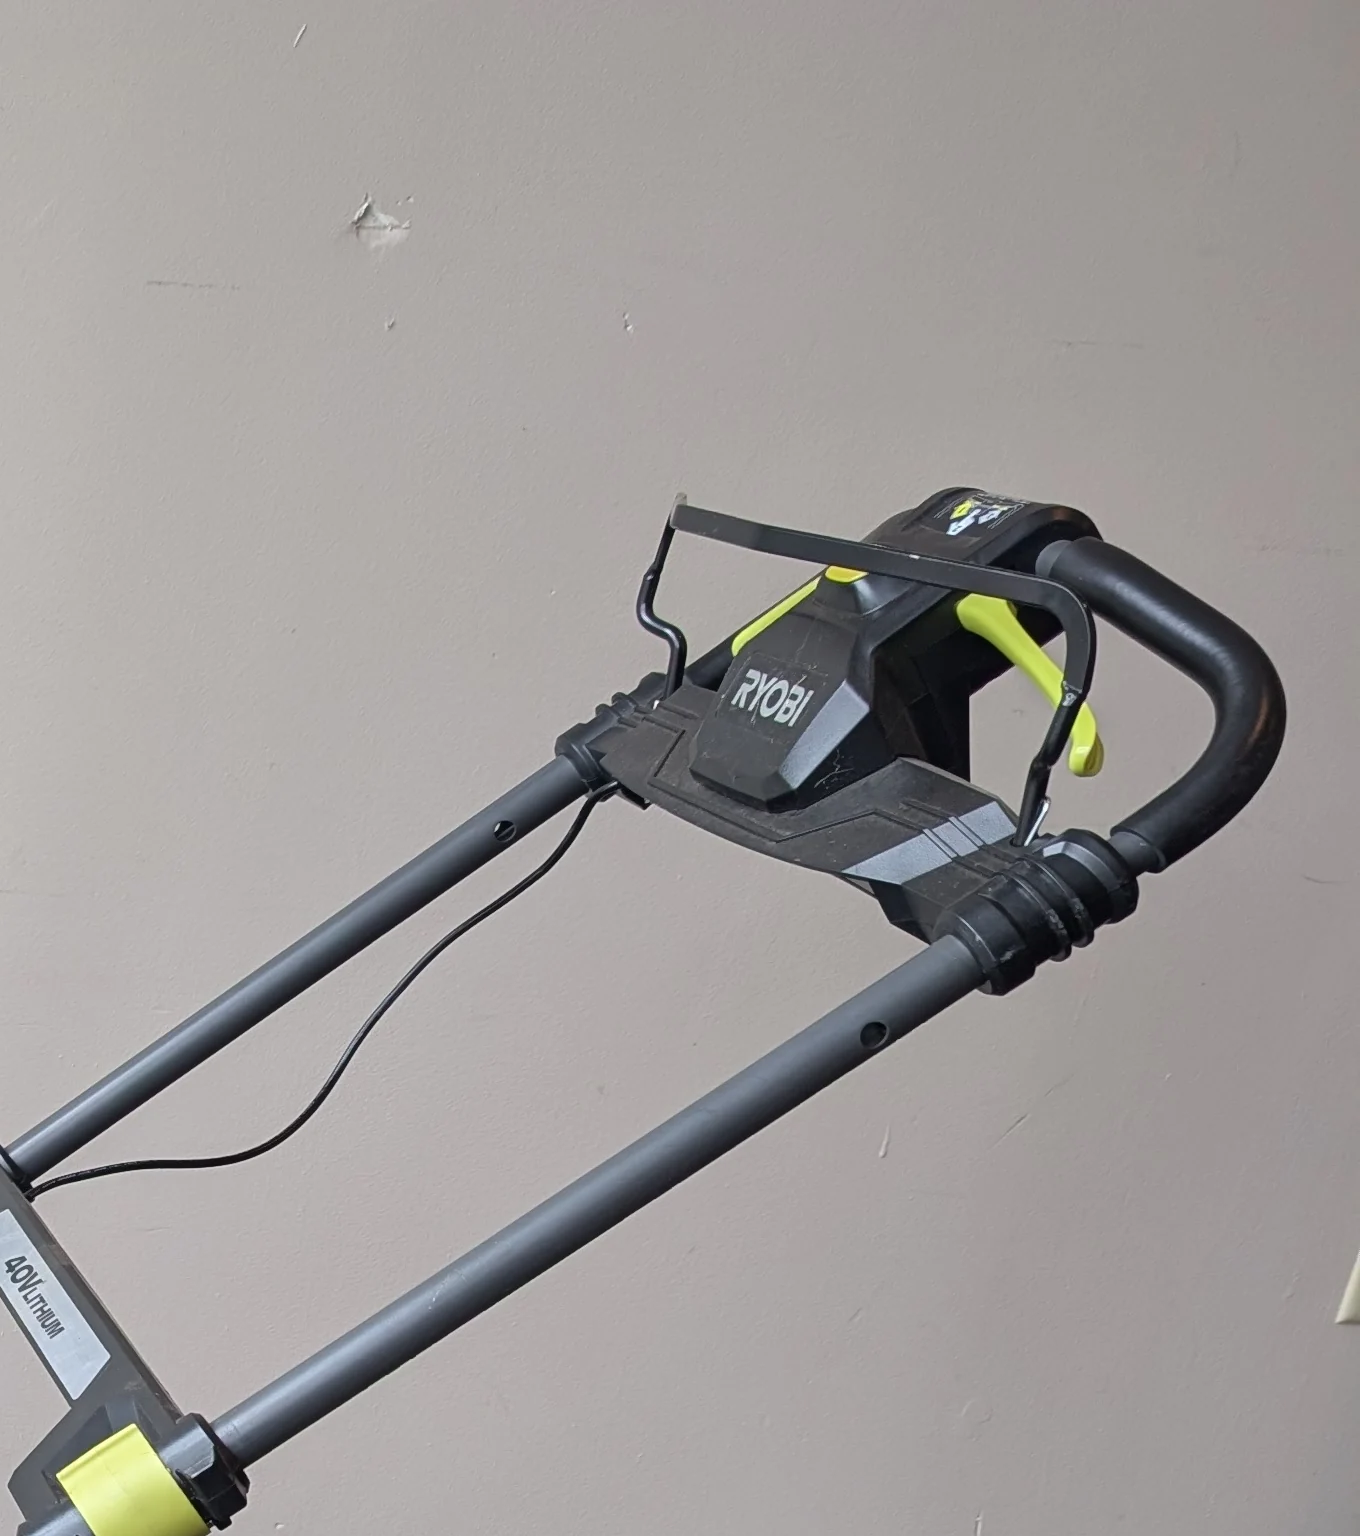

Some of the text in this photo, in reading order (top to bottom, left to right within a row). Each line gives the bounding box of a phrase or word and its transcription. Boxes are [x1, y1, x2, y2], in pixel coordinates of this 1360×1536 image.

[731, 668, 815, 728] RYOBI
[4, 1255, 66, 1340] 40V LITHIUM
